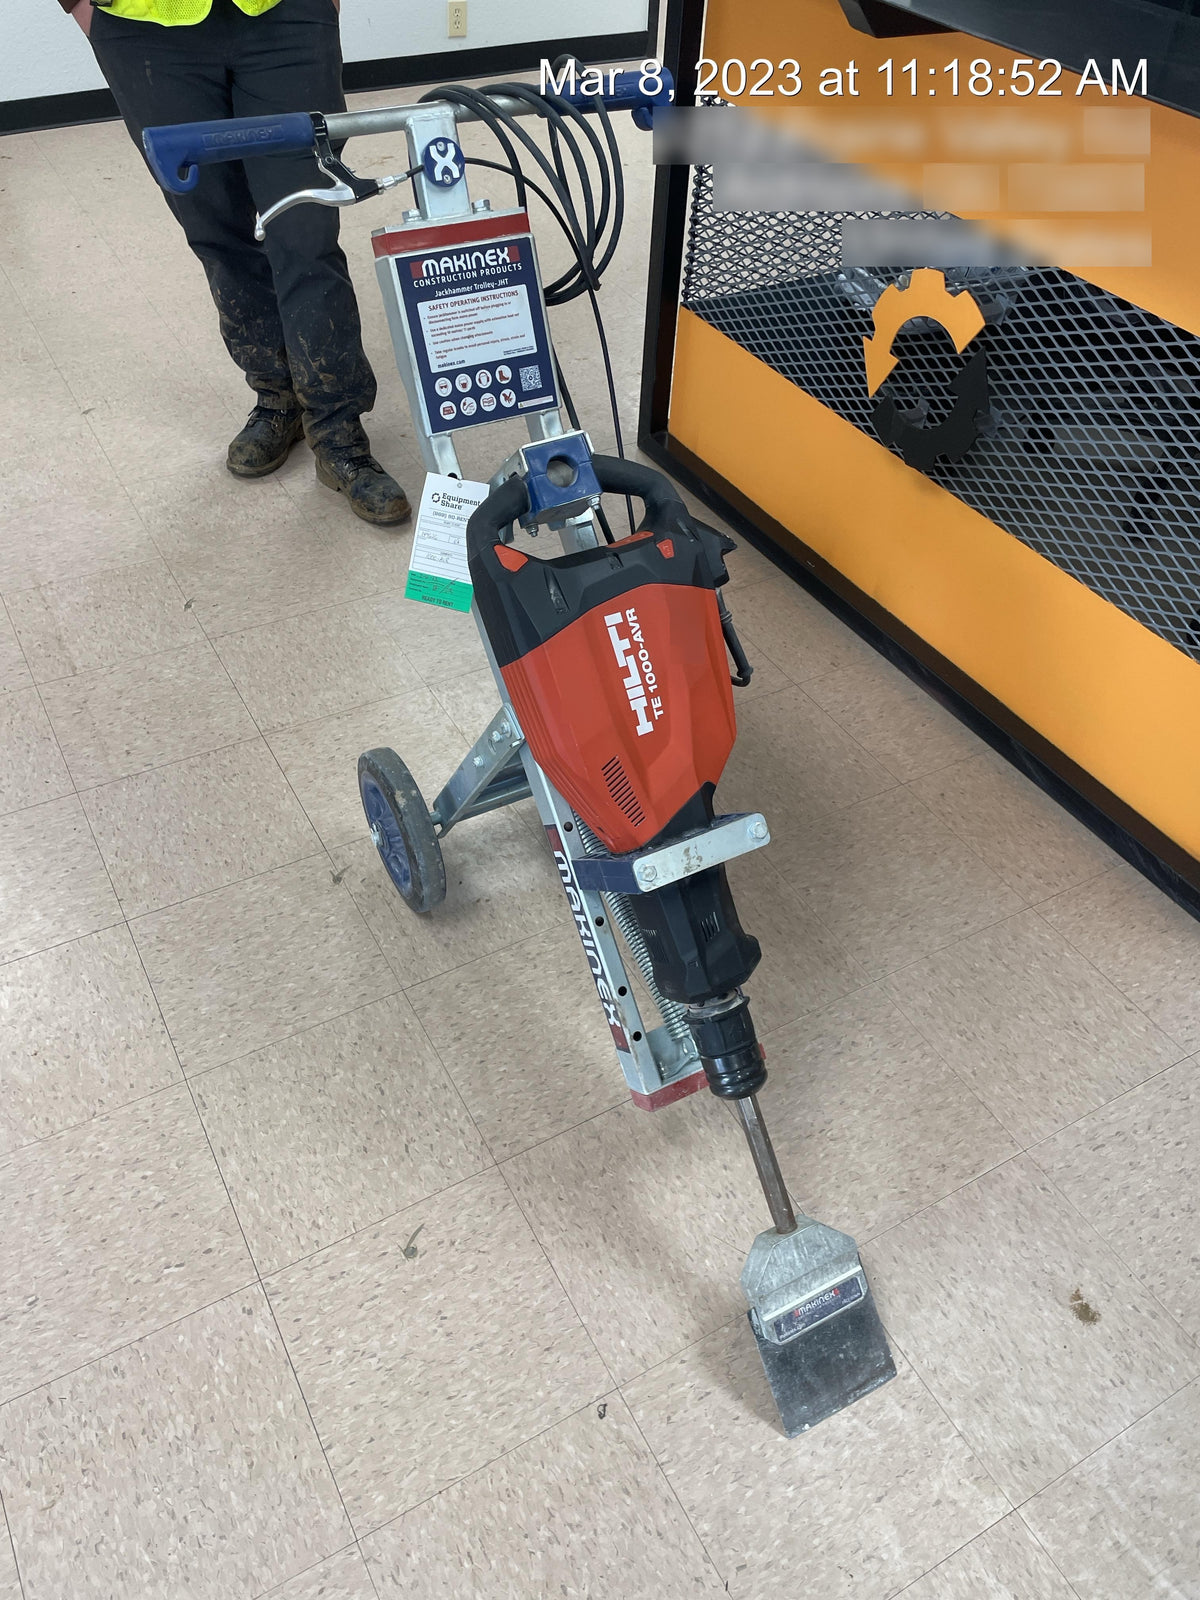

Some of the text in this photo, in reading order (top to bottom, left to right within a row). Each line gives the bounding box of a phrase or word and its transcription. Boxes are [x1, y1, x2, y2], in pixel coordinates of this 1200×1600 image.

[421, 246, 511, 277] MAKINEX
[413, 262, 522, 288] CONSTRUCTION PRODUCTS
[428, 289, 518, 311] SAFETY OPERATING INSTRUCTIONS
[434, 285, 473, 298] Jackhammer
[437, 358, 465, 369] makinex.com
[440, 500, 462, 510] Share
[441, 492, 481, 506] Equipment
[604, 612, 654, 736] HILTI
[625, 607, 664, 720] TE 1000-AVR
[554, 850, 621, 1028] MAKINEX
[798, 1289, 836, 1316] MAKINEX
